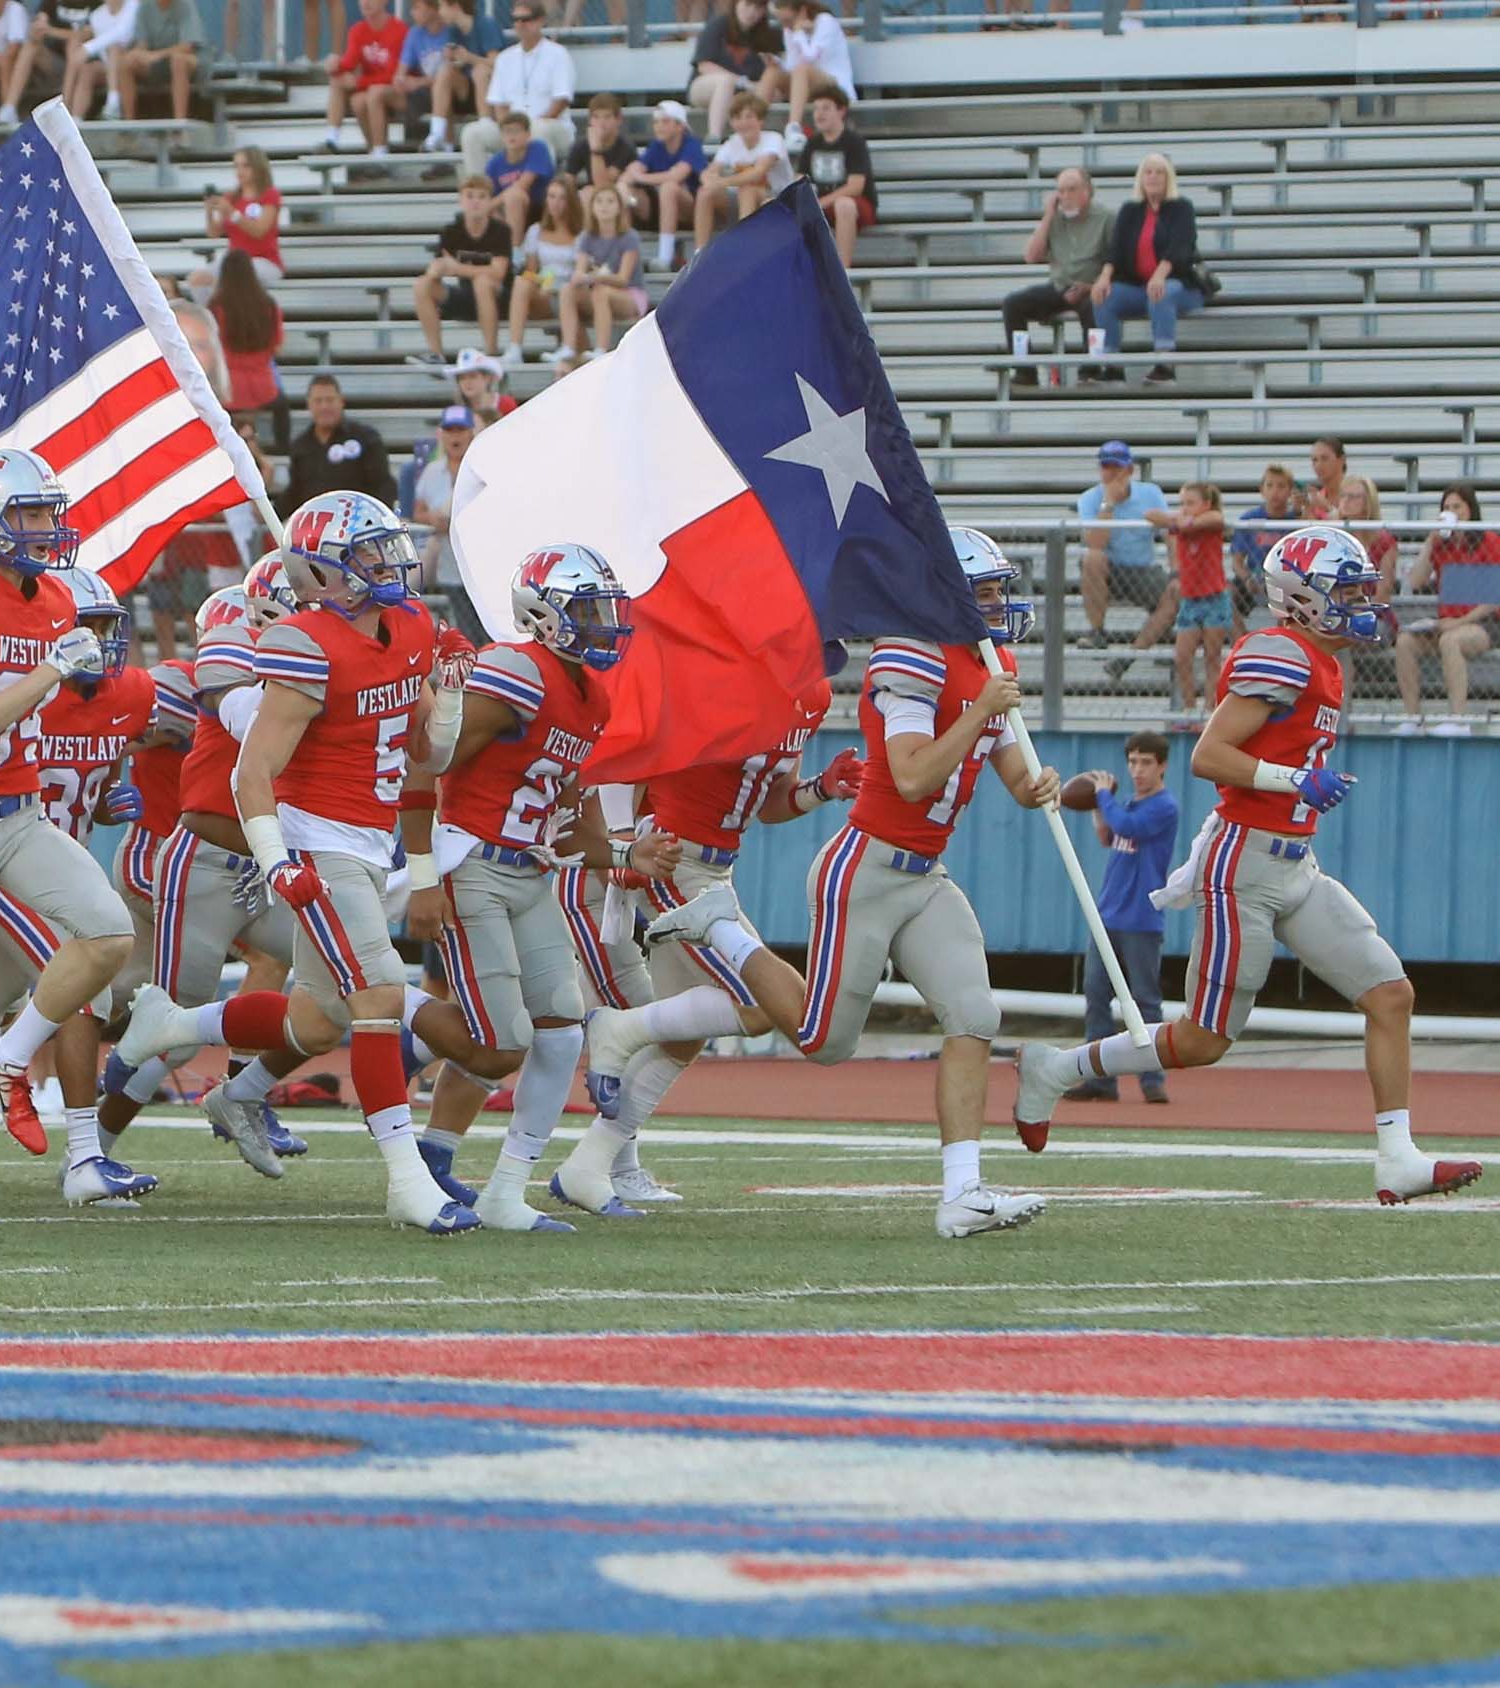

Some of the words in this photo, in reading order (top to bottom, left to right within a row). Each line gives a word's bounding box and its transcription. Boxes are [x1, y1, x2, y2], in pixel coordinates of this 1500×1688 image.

[291, 511, 334, 552] W
[520, 552, 565, 587] W
[1281, 536, 1328, 572] W
[357, 674, 422, 717] WESTLAKE
[41, 735, 127, 761] WESTLAKE
[374, 713, 409, 803] 5
